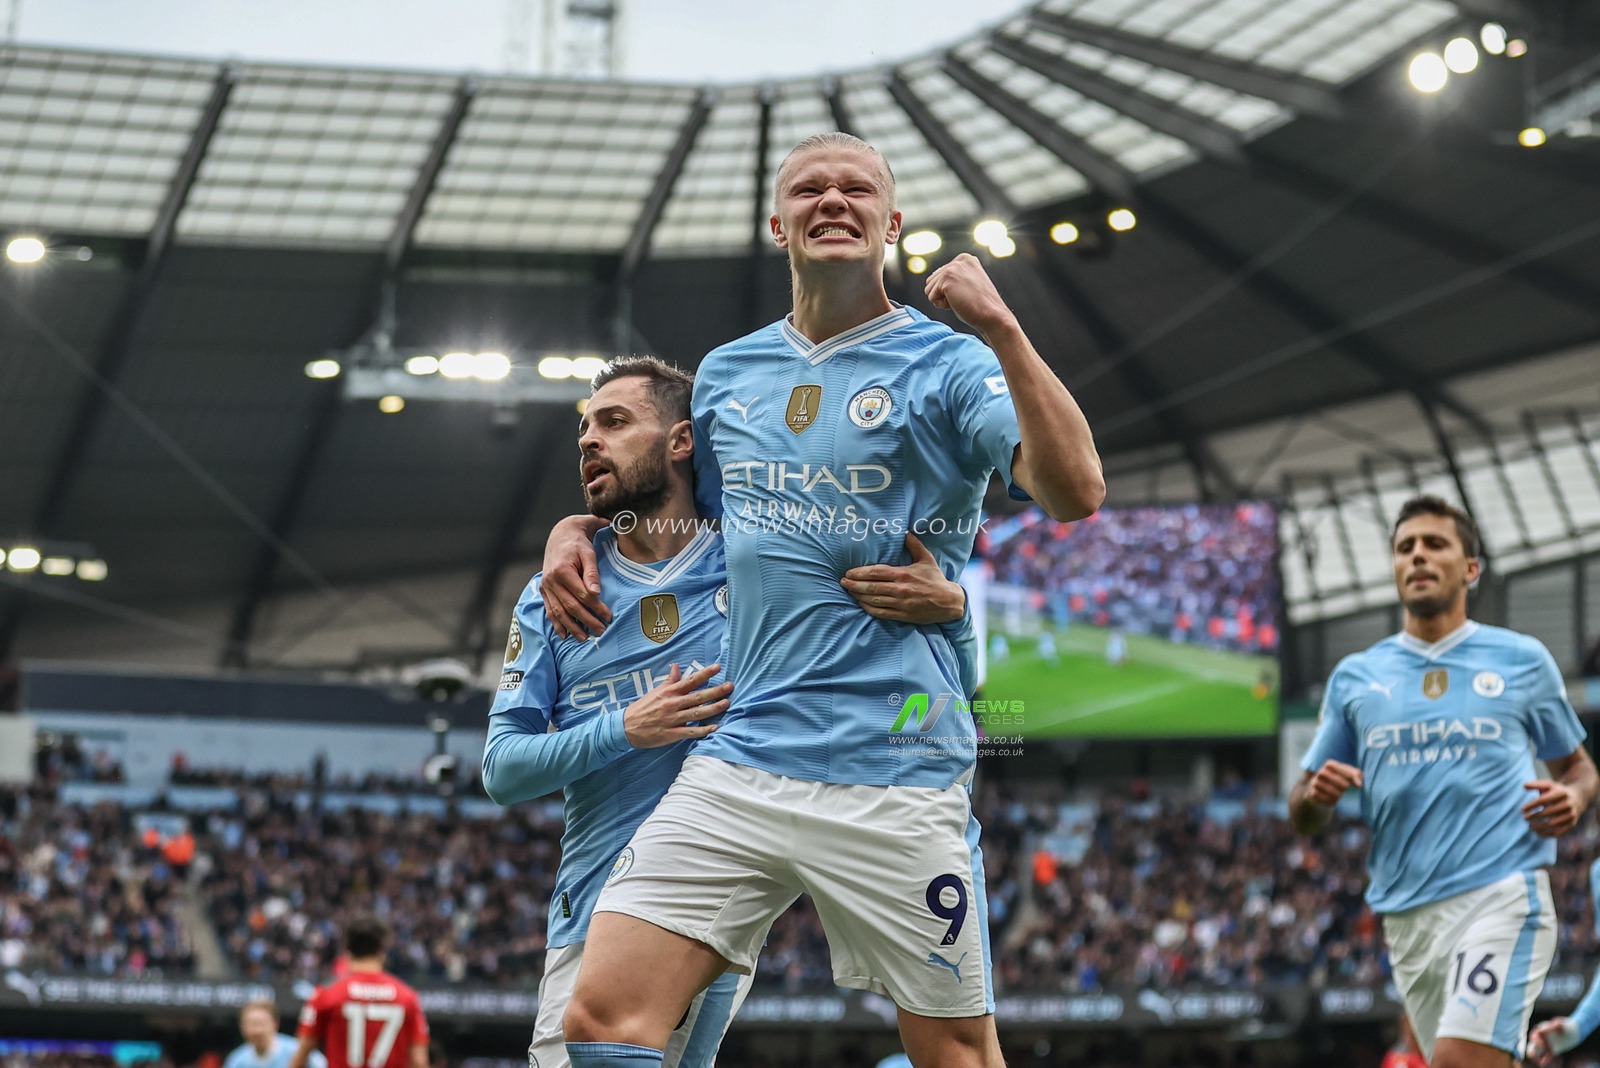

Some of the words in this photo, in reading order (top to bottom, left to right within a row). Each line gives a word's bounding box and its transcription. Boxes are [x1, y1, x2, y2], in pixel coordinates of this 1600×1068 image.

[855, 389, 890, 403] MANCHESTER
[722, 461, 892, 494] ETIHAD
[739, 499, 858, 524] AIRWAYS
[653, 626, 670, 634] FIFA
[1366, 717, 1502, 748] ETIHAD
[1387, 744, 1477, 766] AIRWAYS
[926, 873, 968, 945] 9
[1452, 952, 1498, 996] 16
[342, 1001, 405, 1068] 17
